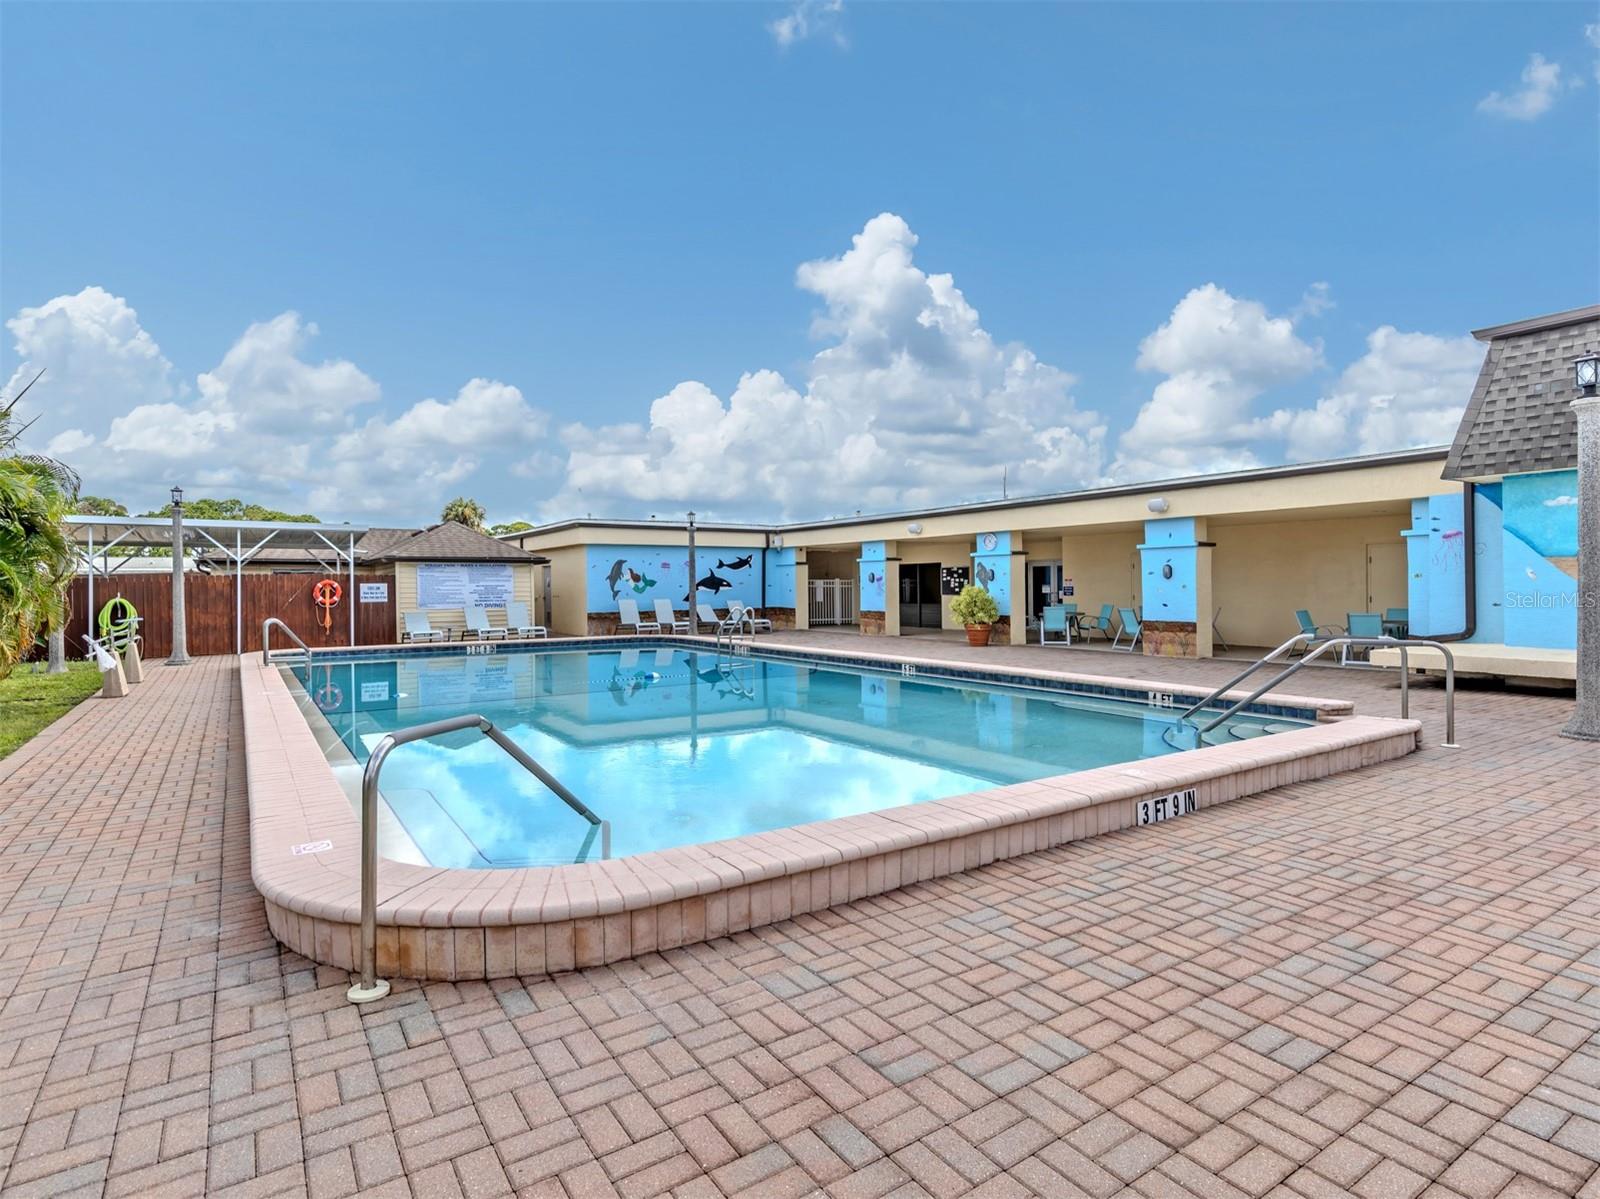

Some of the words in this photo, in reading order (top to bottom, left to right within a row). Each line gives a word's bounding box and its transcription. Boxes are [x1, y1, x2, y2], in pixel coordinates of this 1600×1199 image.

[1161, 693, 1171, 701] FT
[1142, 802, 1149, 824] 3
[1154, 798, 1167, 822] FT
[1173, 795, 1179, 816] 9
[1184, 790, 1195, 813] IN
